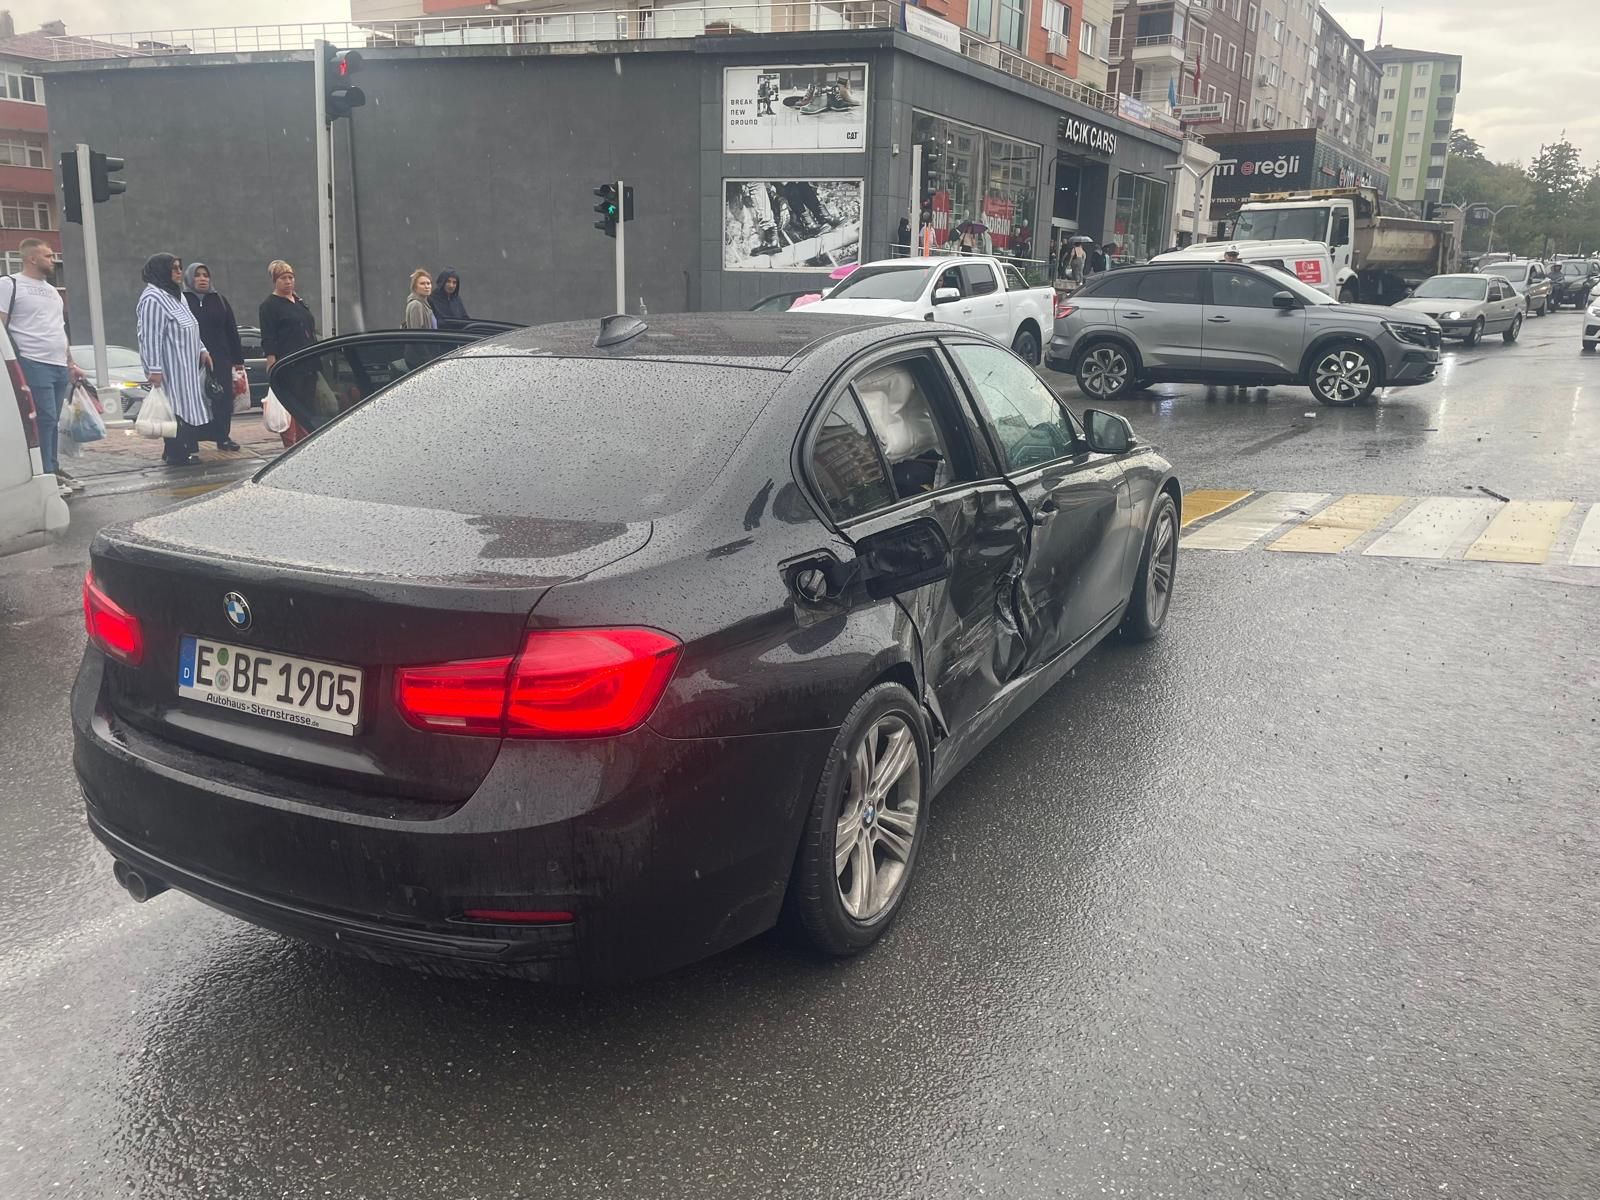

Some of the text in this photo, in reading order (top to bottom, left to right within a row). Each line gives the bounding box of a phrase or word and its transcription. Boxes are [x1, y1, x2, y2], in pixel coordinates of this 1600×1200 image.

[730, 98, 753, 106] BREAK
[846, 131, 858, 140] CAT
[1065, 118, 1118, 155] AÇIK ÇARŞI
[1241, 155, 1300, 178] ereğli
[183, 667, 190, 679] D
